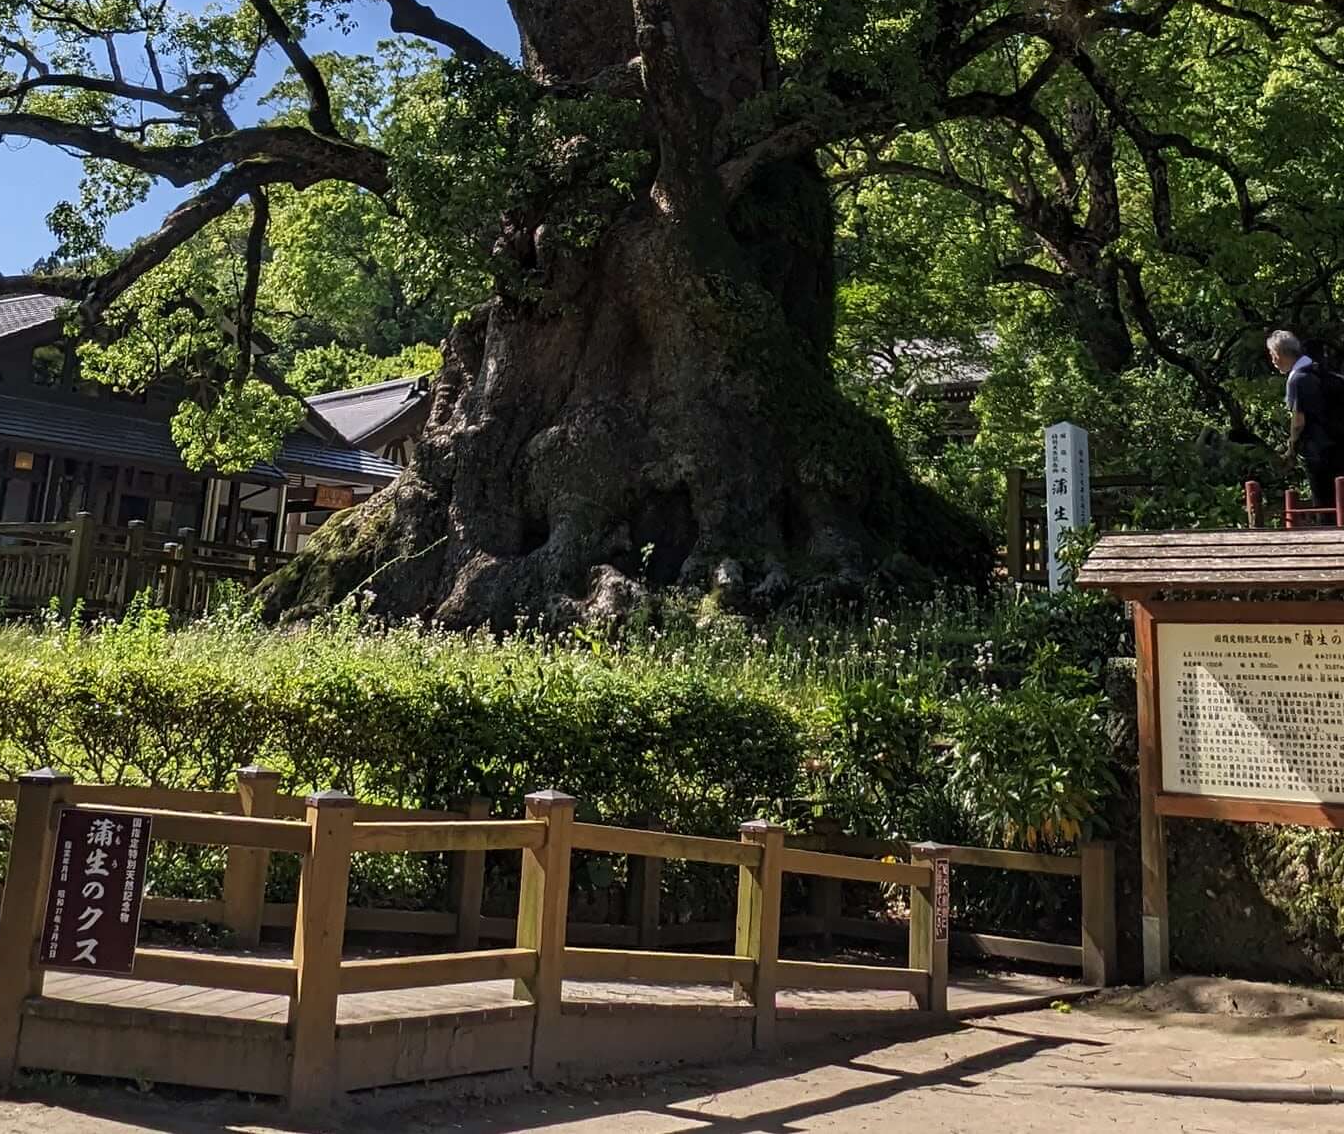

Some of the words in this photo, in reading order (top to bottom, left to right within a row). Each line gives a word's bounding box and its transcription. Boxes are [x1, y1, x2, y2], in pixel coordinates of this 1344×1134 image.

[72, 818, 116, 965] 蒲生のクス
[119, 818, 143, 923] 国指定特別天然記念物
